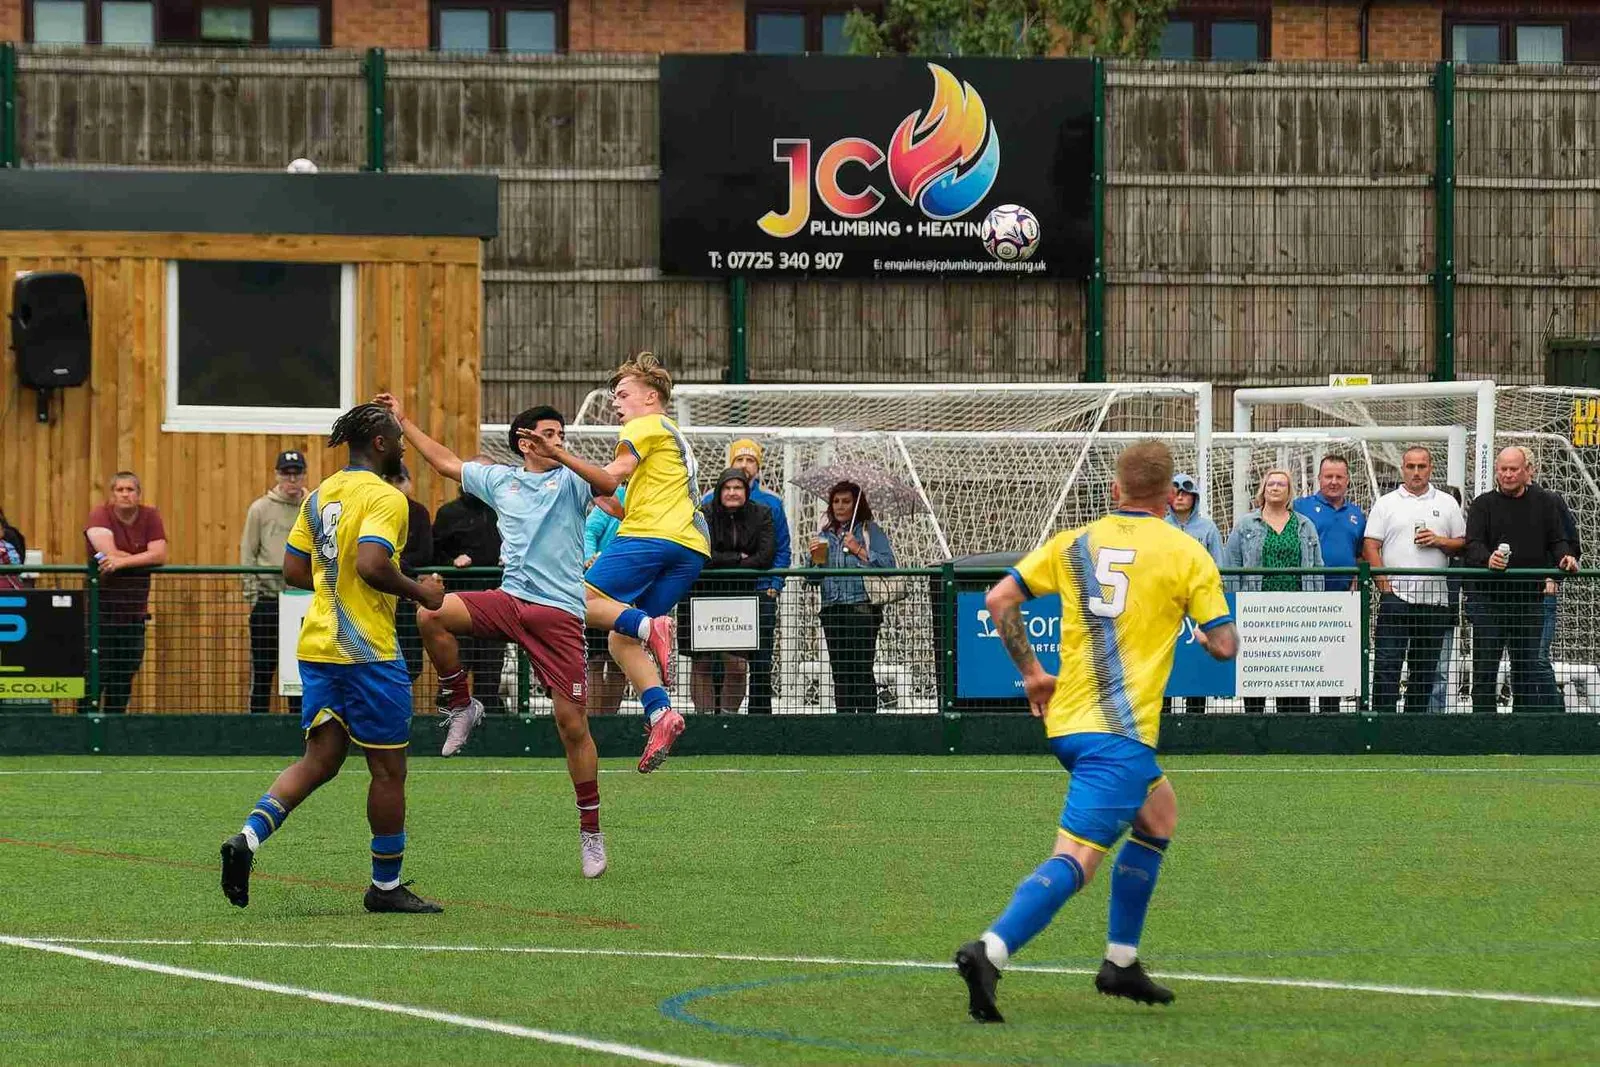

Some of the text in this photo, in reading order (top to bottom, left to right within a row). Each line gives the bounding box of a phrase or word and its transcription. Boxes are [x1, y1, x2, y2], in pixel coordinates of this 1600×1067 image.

[757, 137, 886, 238] JC
[810, 219, 983, 238] PLUMBING HEATIN
[708, 251, 844, 270] T: 07725 340 907
[873, 258, 1047, 273] E: enquiries@jcplumbingandheating.uk
[1088, 547, 1137, 619] 5
[1242, 605, 1343, 614] AUDIT AND ACCOUNTANCY
[1242, 620, 1353, 629] BOOKKEEPING AND PAYROLL
[1242, 635, 1346, 643] TAX PLANNING AND ADVICE
[1242, 650, 1322, 658] BUSINESS ADVISORY
[1242, 665, 1325, 673] CORPORATE FINANCE
[1242, 679, 1345, 688] CRYPTO ASSET TAX ADVICE
